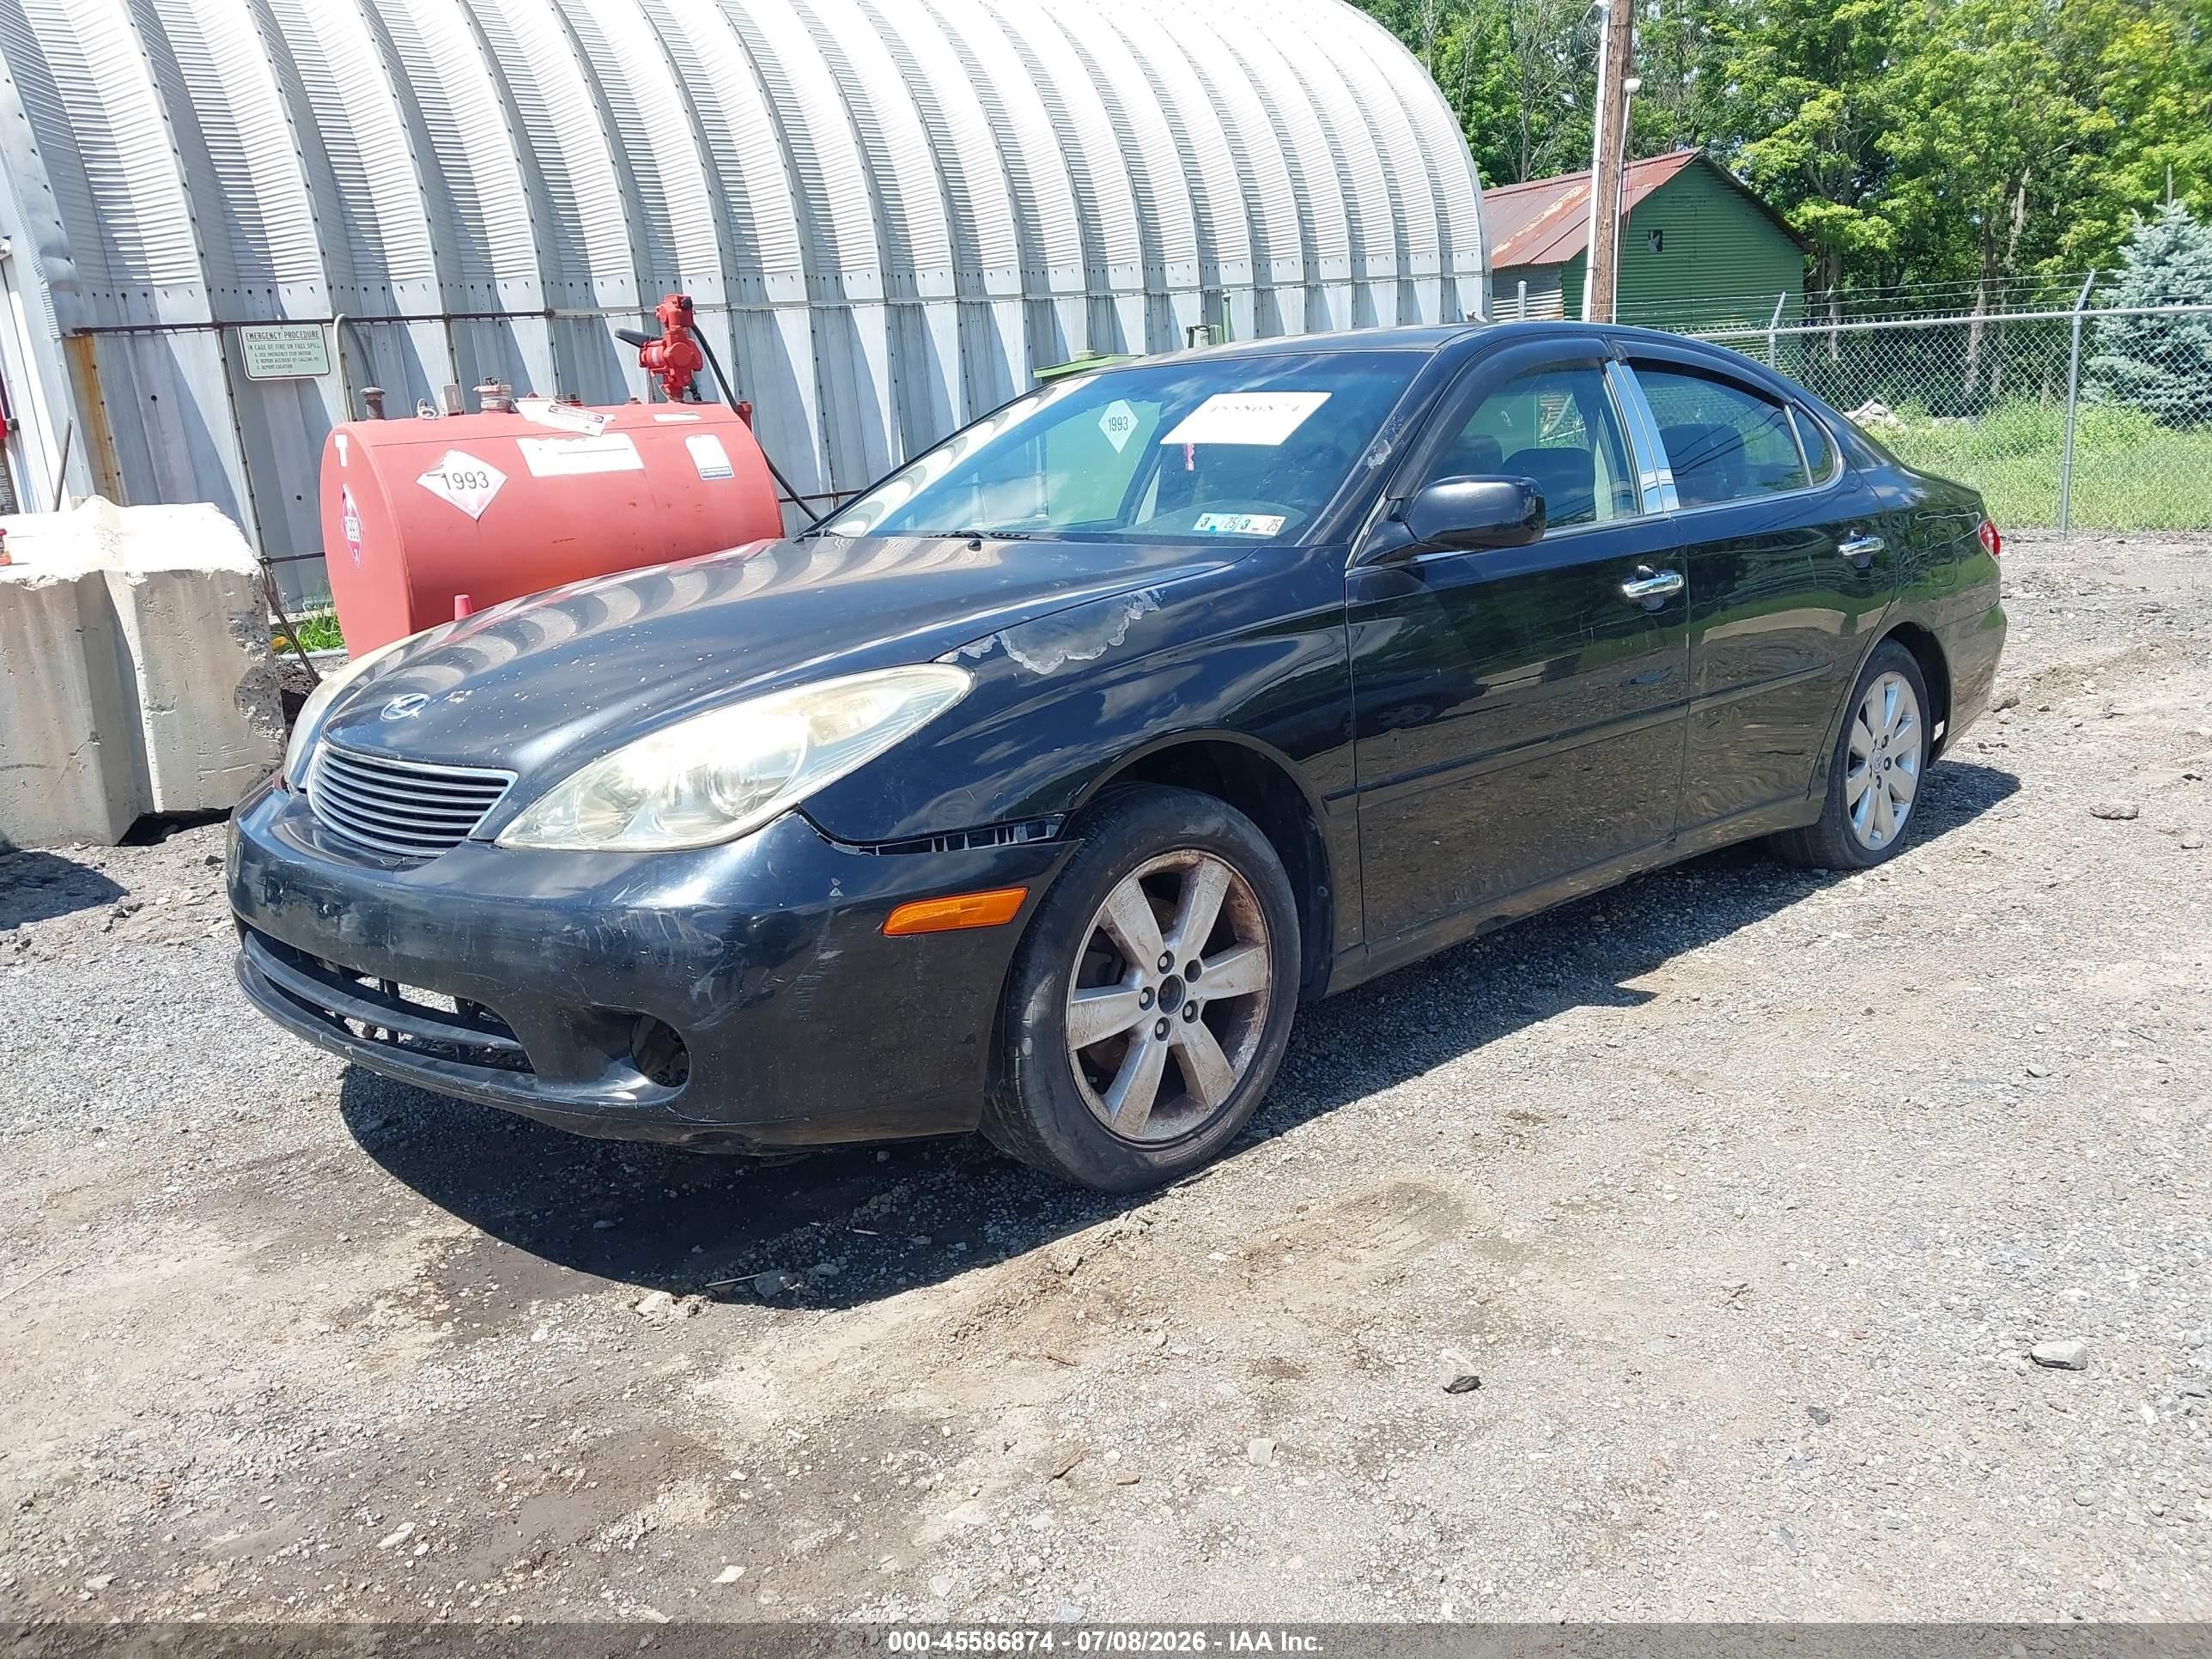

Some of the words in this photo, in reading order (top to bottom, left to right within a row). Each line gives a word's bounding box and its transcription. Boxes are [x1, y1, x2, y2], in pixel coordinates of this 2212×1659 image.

[246, 331, 281, 340] EMERGENCY
[284, 330, 320, 339] PROCEDURE
[1107, 416, 1128, 432] 1993
[441, 471, 489, 490] 1993
[1200, 517, 1211, 528] 3
[1240, 519, 1251, 530] 3
[1267, 519, 1282, 532] 25
